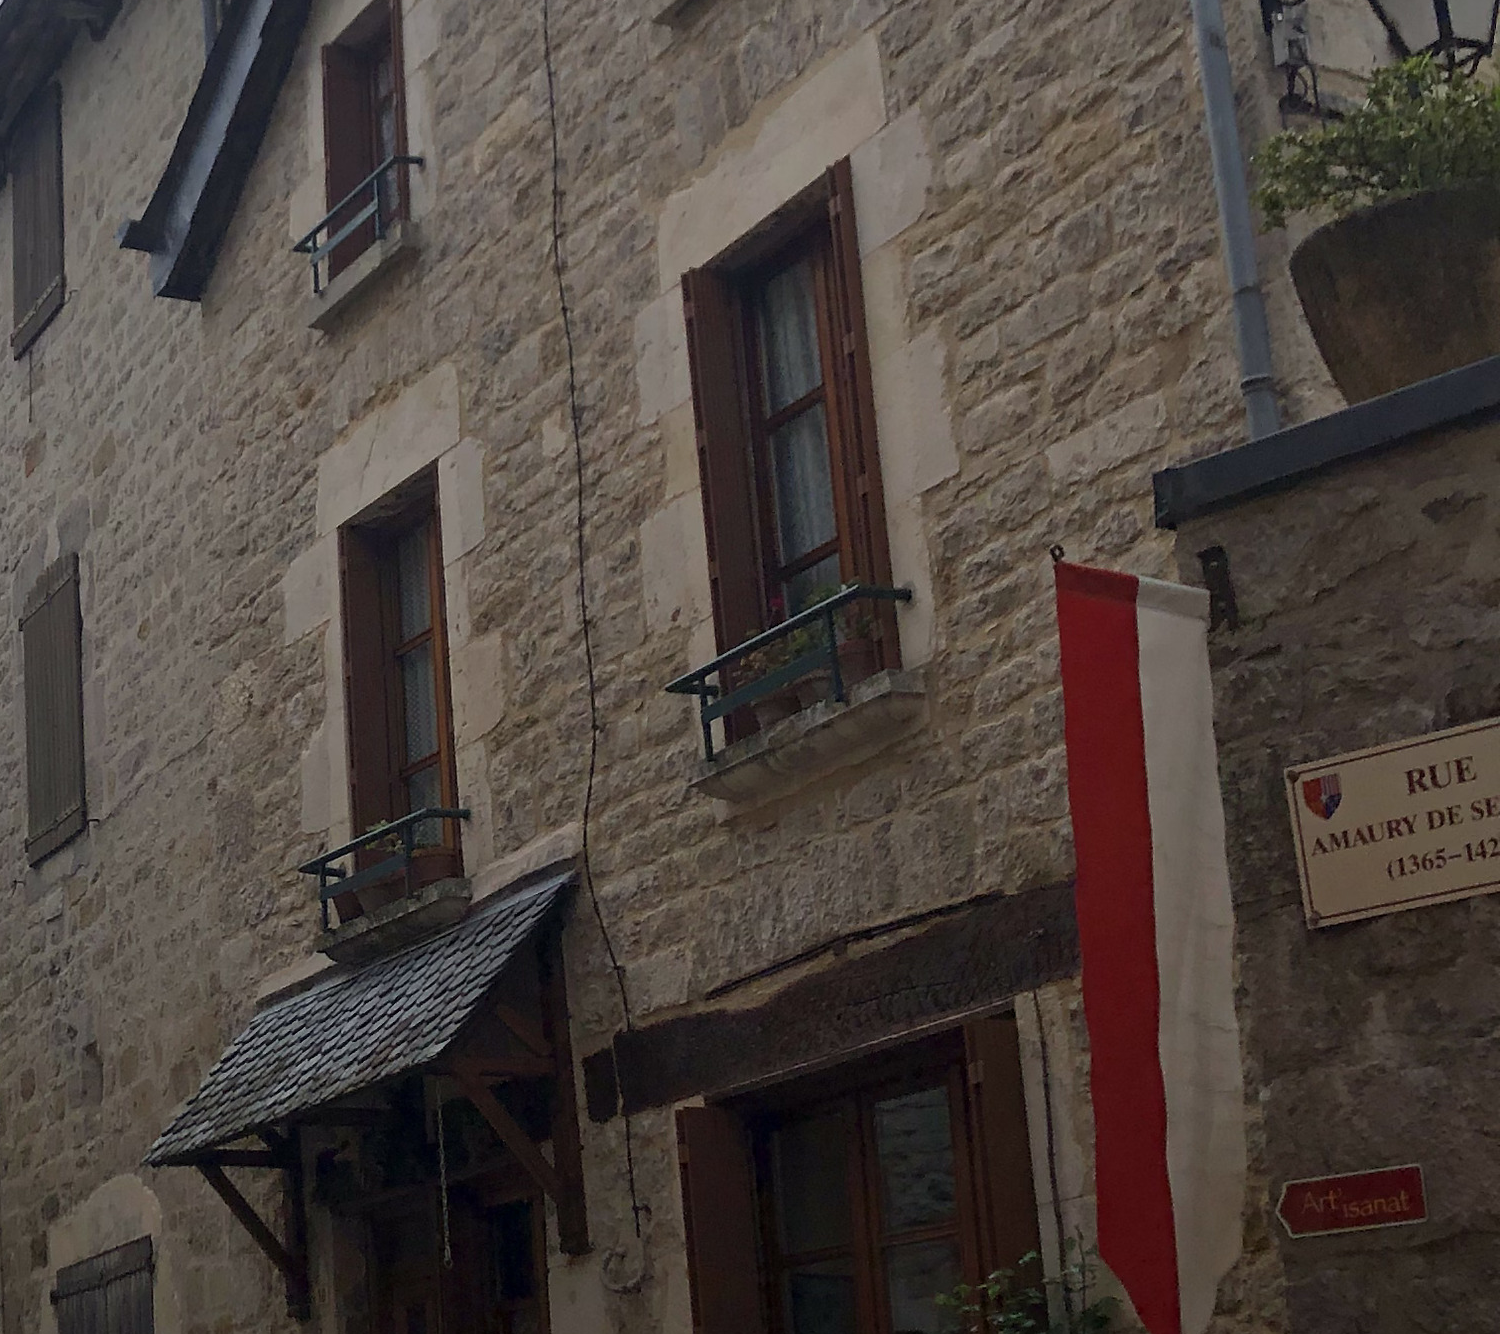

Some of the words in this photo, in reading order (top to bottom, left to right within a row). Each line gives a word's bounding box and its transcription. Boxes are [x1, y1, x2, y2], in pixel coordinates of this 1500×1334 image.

[1404, 755, 1477, 796] RUE
[1311, 814, 1417, 857] AMAURY
[1427, 804, 1464, 831] DE
